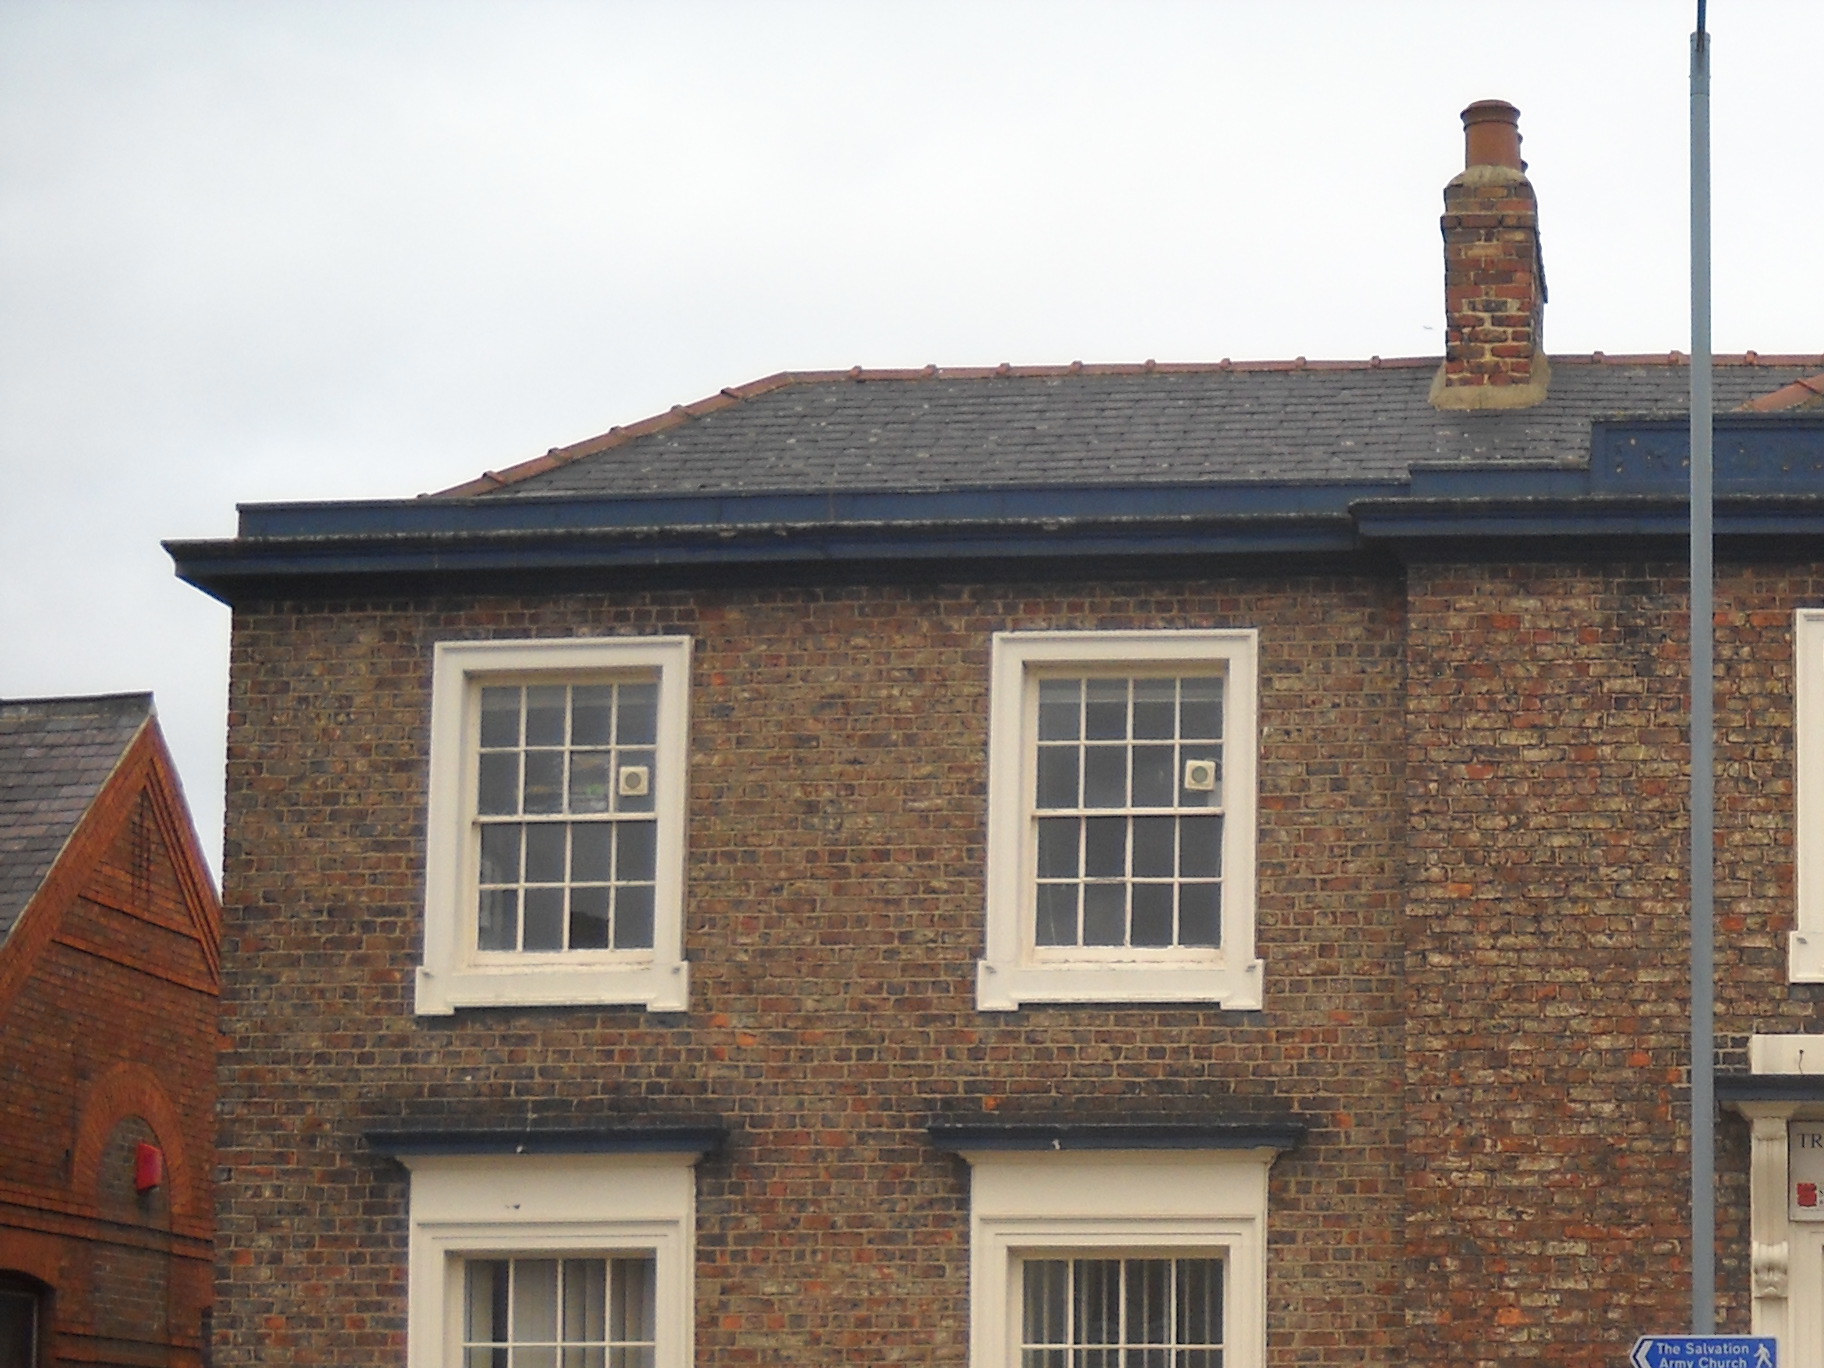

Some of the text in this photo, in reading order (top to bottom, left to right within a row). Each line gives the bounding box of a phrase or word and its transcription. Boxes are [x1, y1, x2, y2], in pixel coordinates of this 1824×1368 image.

[1657, 1342, 1749, 1355] The Salvation
[1699, 1356, 1747, 1368] Church
